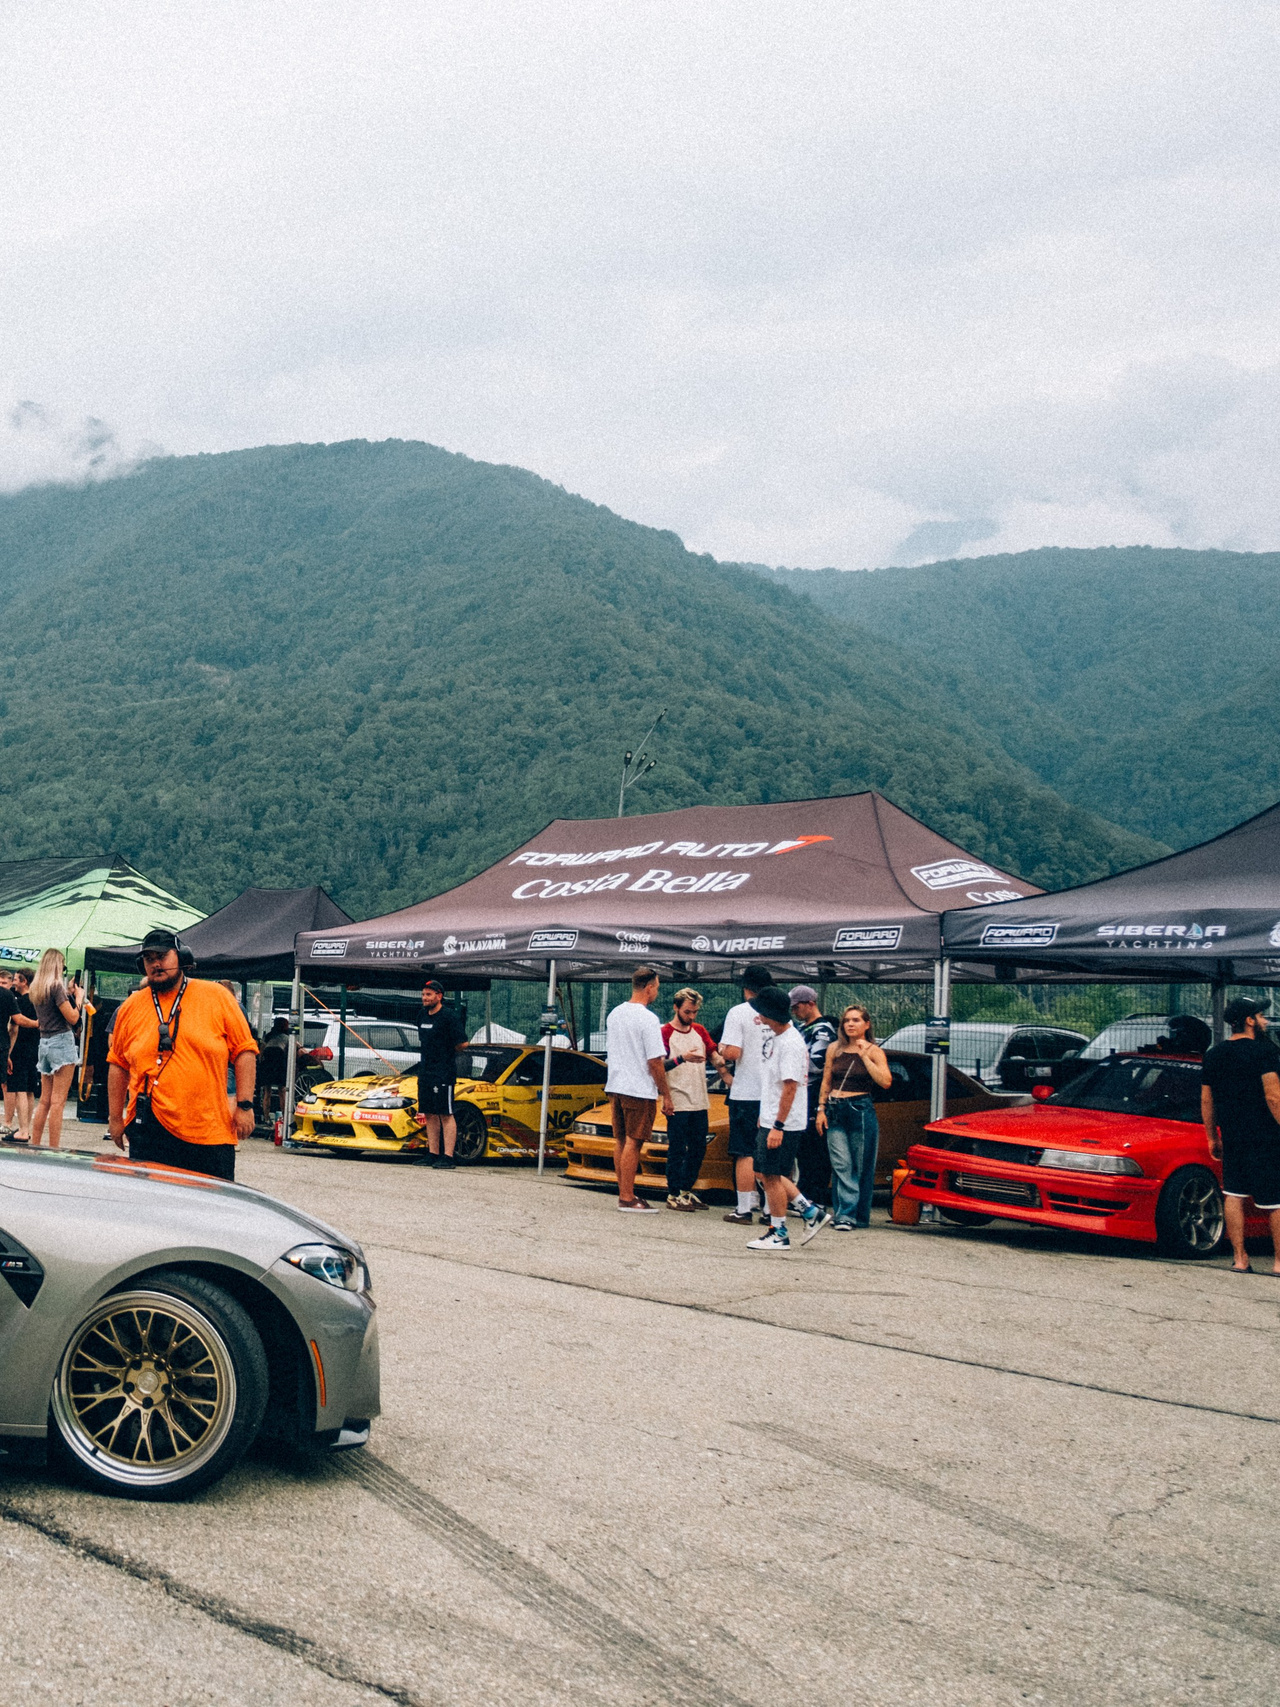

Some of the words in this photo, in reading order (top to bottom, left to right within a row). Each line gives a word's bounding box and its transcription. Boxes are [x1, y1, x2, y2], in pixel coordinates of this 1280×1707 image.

[509, 841, 664, 866] FORWARD
[661, 841, 770, 857] AUTO
[512, 871, 630, 899] Costa
[626, 869, 751, 893] Bella
[533, 933, 575, 942] FORWARD
[616, 931, 651, 943] Costa
[839, 930, 898, 940] FORWARD
[986, 927, 1052, 937] FORWARD
[458, 938, 506, 952] TAKAYAMA
[618, 942, 649, 953] Bella
[712, 936, 786, 952] VIRAGE
[1106, 940, 1213, 949] YACHTING
[321, 1086, 367, 1098] MAHLE
